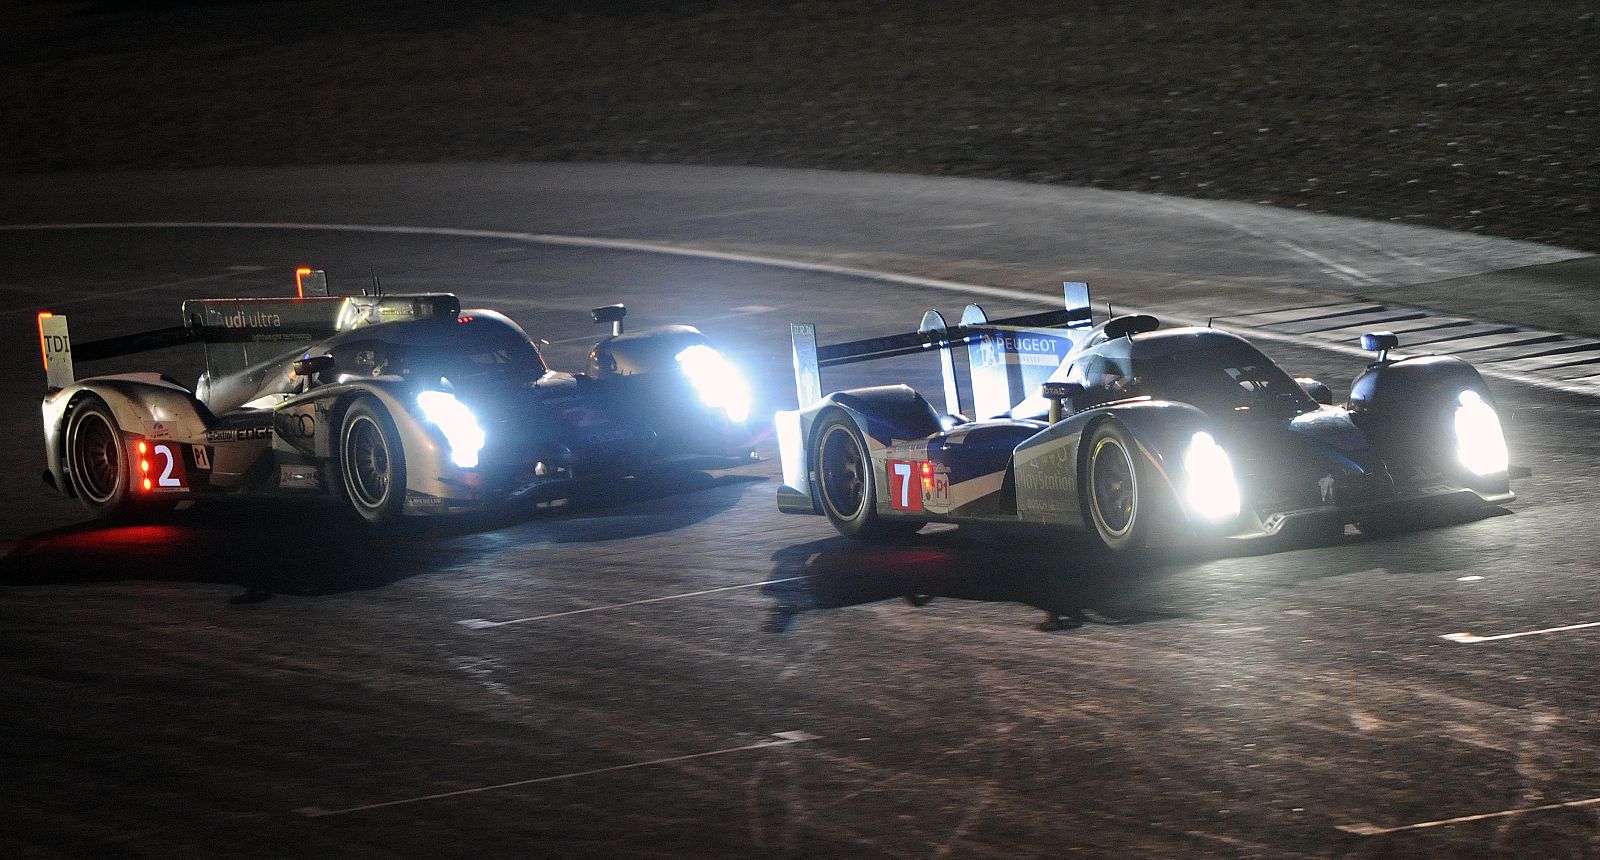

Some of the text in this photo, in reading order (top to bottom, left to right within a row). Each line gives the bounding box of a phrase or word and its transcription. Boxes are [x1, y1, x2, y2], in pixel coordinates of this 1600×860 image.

[220, 311, 280, 329] udi ultra
[44, 335, 69, 352] TDI
[997, 337, 1057, 352] PEUGEOT
[154, 444, 181, 487] 2
[194, 445, 208, 466] P1
[894, 463, 911, 508] 7
[937, 479, 949, 499] P1
[1016, 469, 1076, 495] PlayStation
